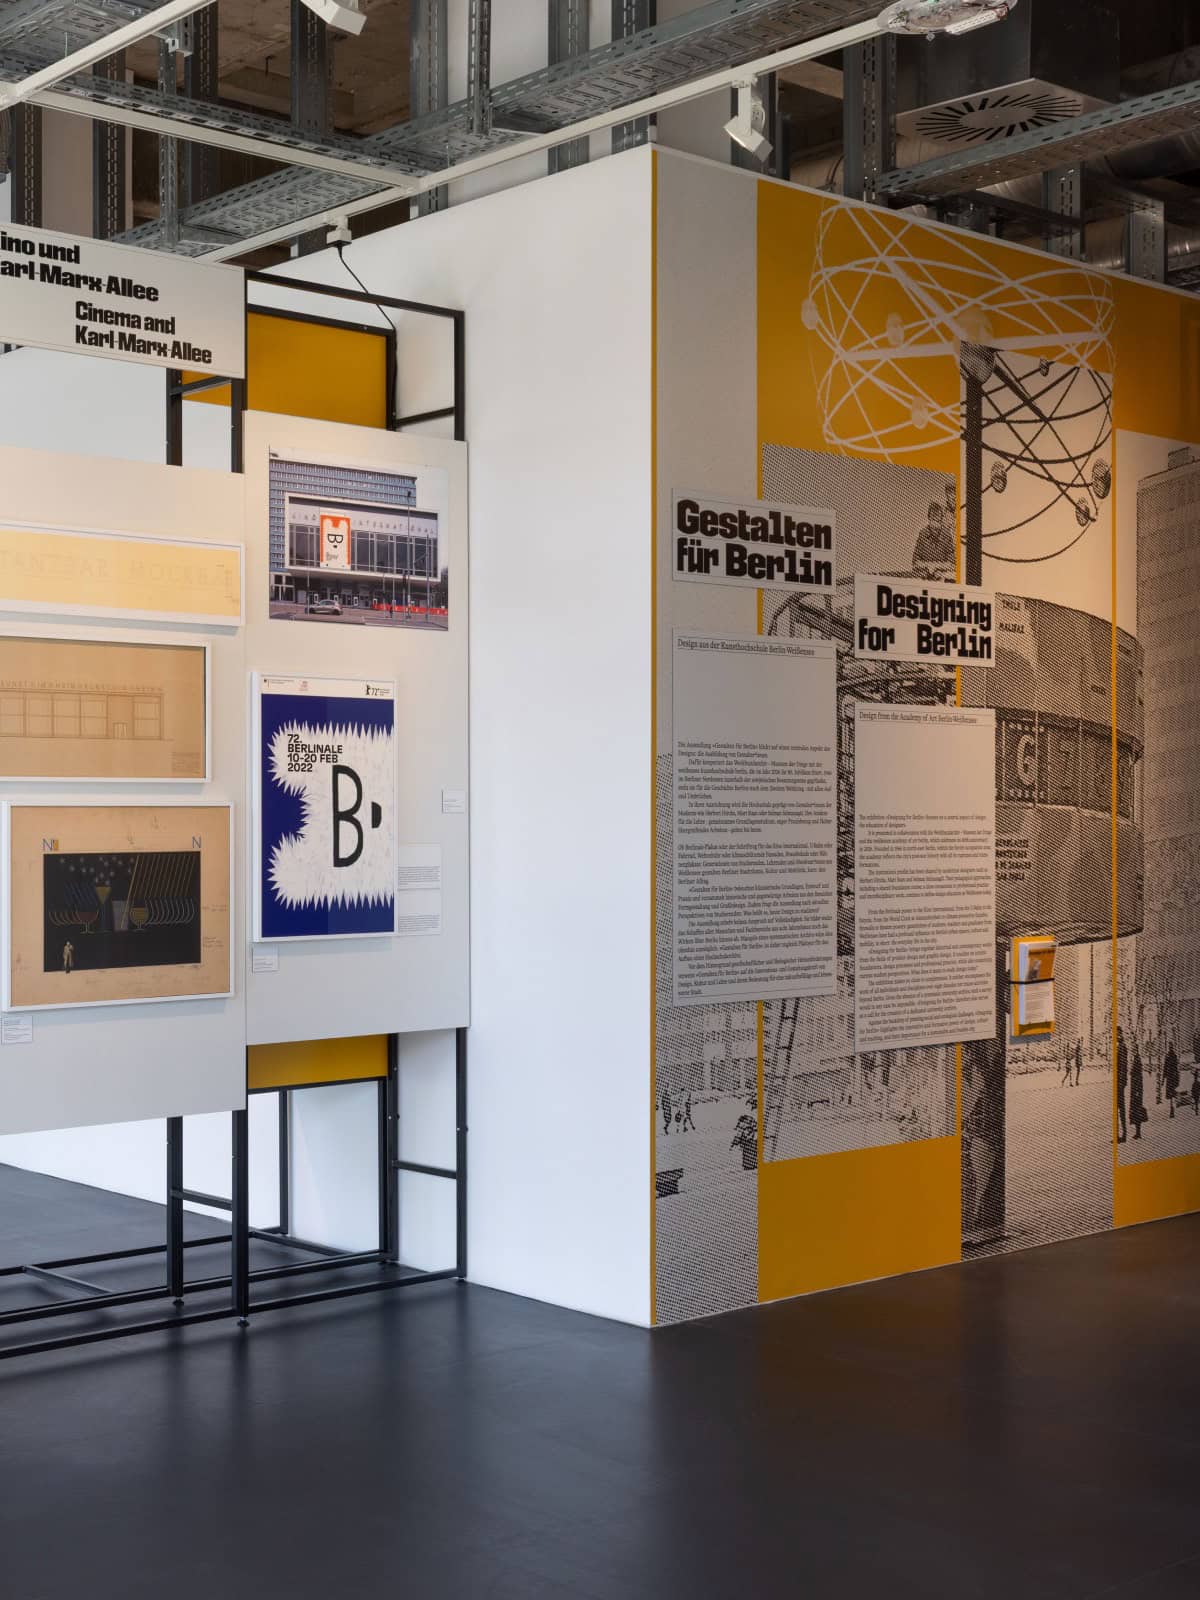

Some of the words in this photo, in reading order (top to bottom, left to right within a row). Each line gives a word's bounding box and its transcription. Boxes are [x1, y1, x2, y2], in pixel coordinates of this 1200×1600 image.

[38, 244, 81, 264] und
[75, 301, 142, 330] Cinema
[144, 317, 176, 335] and
[75, 324, 212, 364] Karl-Marx-Allee
[677, 499, 832, 549] Gestalten
[677, 537, 719, 574] für
[725, 542, 832, 585] Berlin
[877, 585, 991, 632] Designing
[677, 639, 697, 650] Design
[700, 640, 709, 649] aus
[710, 641, 720, 649] der
[769, 646, 786, 654] Berlin
[859, 618, 895, 651] for
[917, 623, 991, 659] Berlin
[859, 711, 877, 720] Design
[878, 711, 890, 720] from
[891, 712, 899, 720] the
[900, 713, 921, 723] Academy
[287, 734, 303, 744] 72.
[287, 743, 343, 754] BERLINALE
[287, 753, 317, 763] 10-20
[320, 754, 339, 763] FEB
[287, 762, 313, 773] 2022
[332, 764, 364, 868] B
